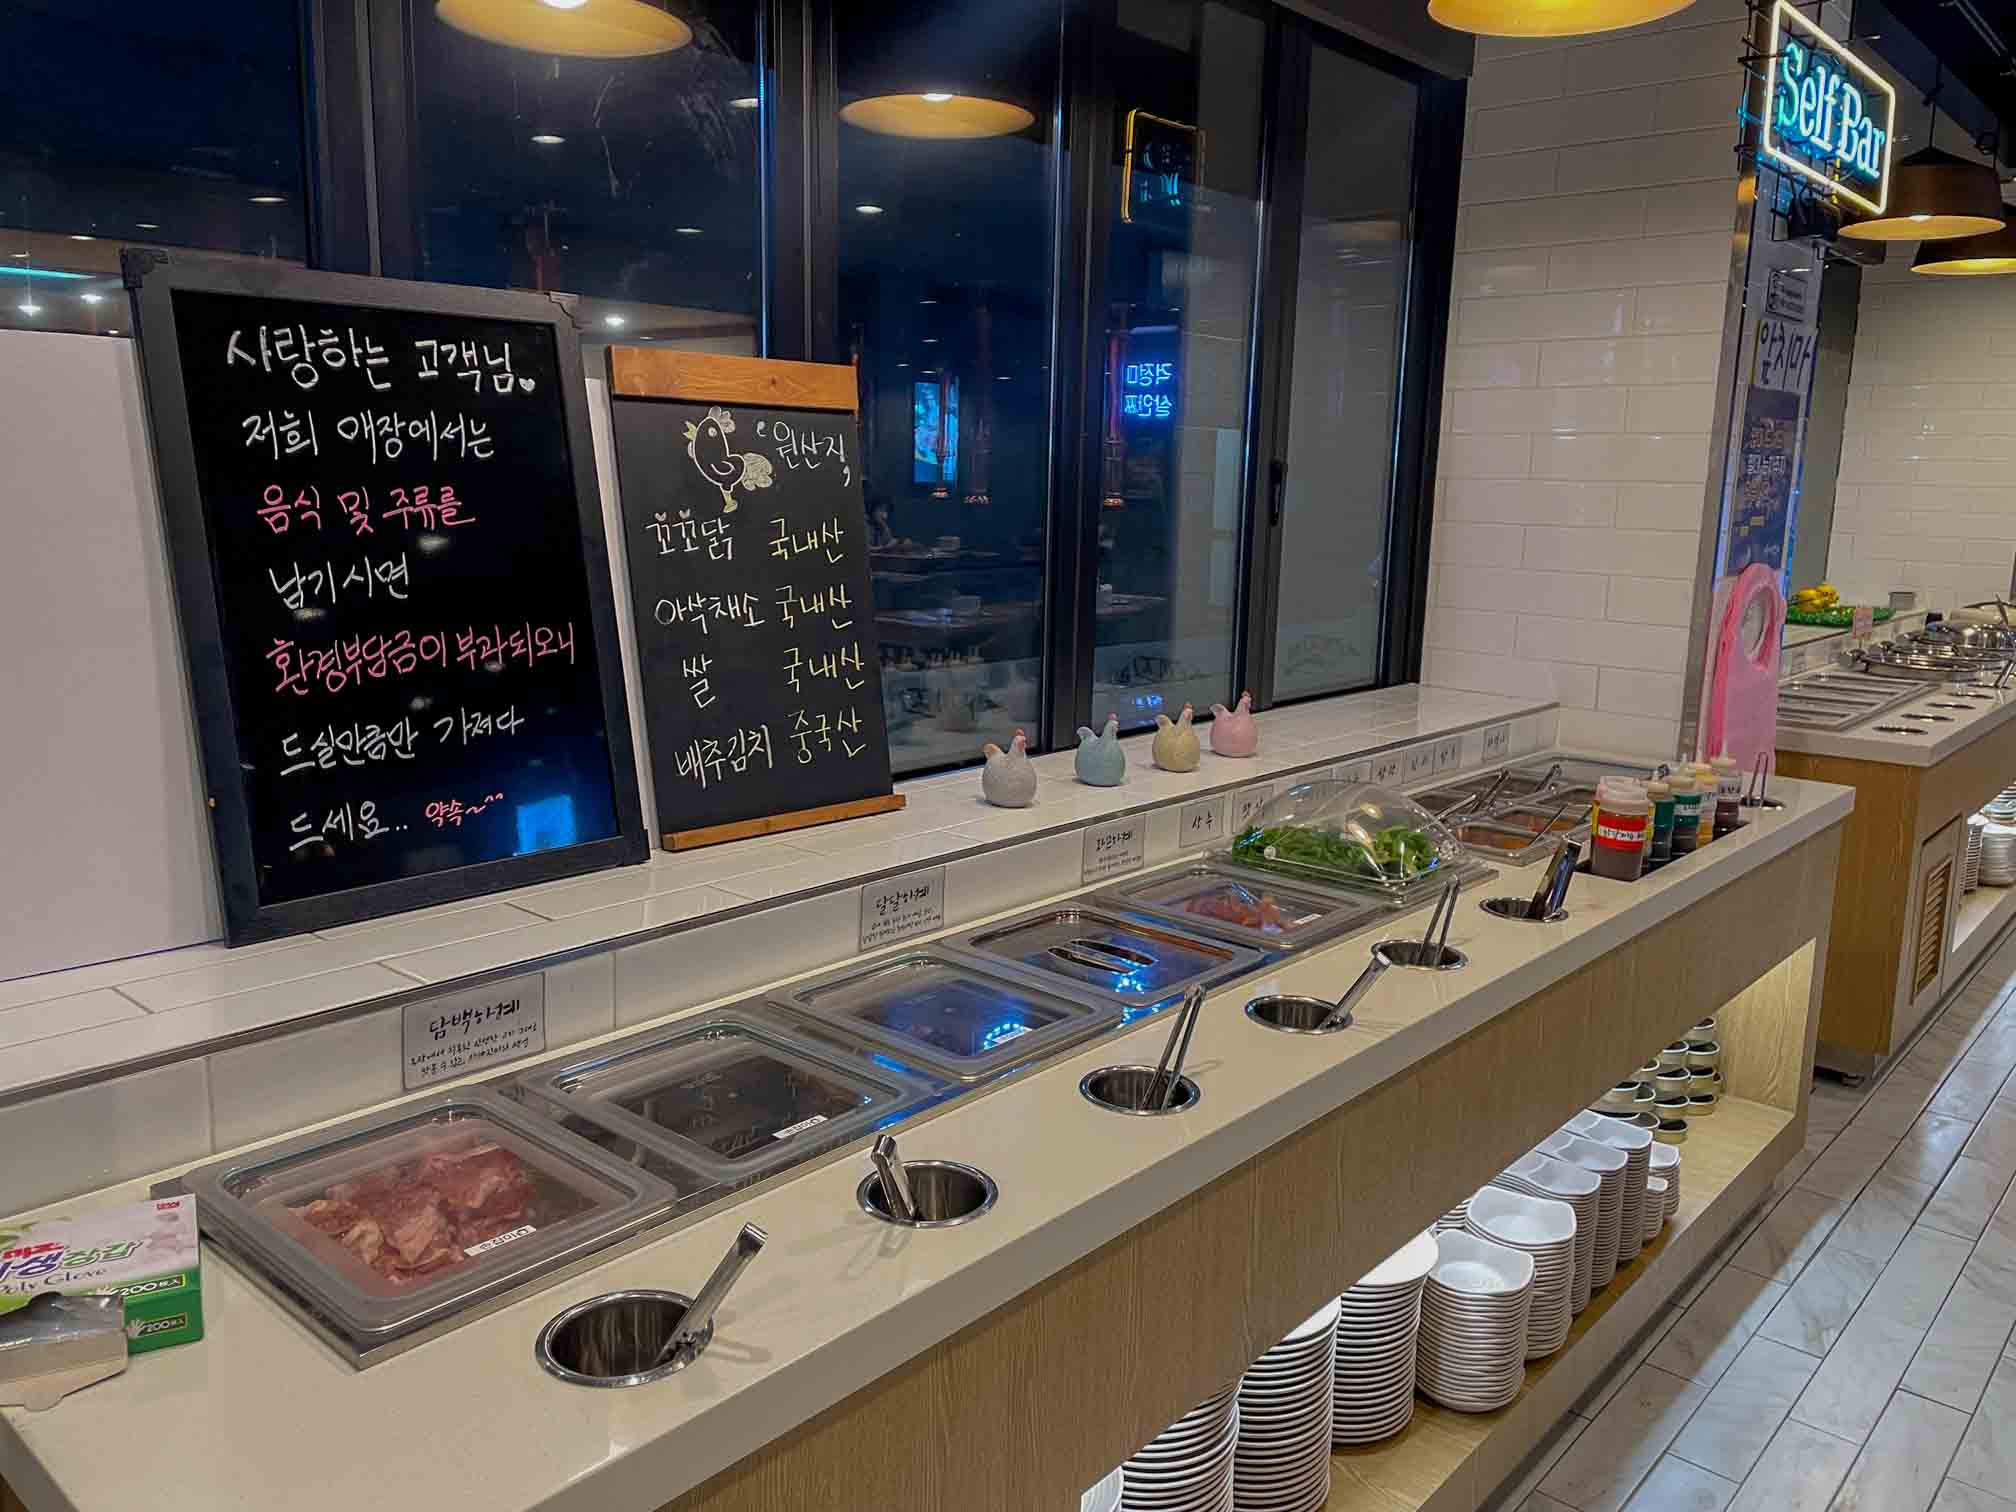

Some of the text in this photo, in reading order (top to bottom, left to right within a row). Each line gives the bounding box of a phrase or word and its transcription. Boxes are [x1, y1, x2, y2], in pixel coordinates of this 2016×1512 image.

[1777, 42, 1886, 178] Self Bar
[226, 324, 514, 393] 사랑하는 고객님
[241, 409, 495, 464] 저희 매장에서는
[256, 484, 476, 535] 음식 및 주류를
[645, 508, 844, 564] 꼬꼬닭 국내산
[775, 583, 853, 630] 국내산
[265, 620, 576, 695] 환경부담금이 부과되오니
[683, 640, 865, 709] 쌀 국내산
[433, 704, 525, 746] 가져다
[674, 706, 867, 790] 배추김치 중국산
